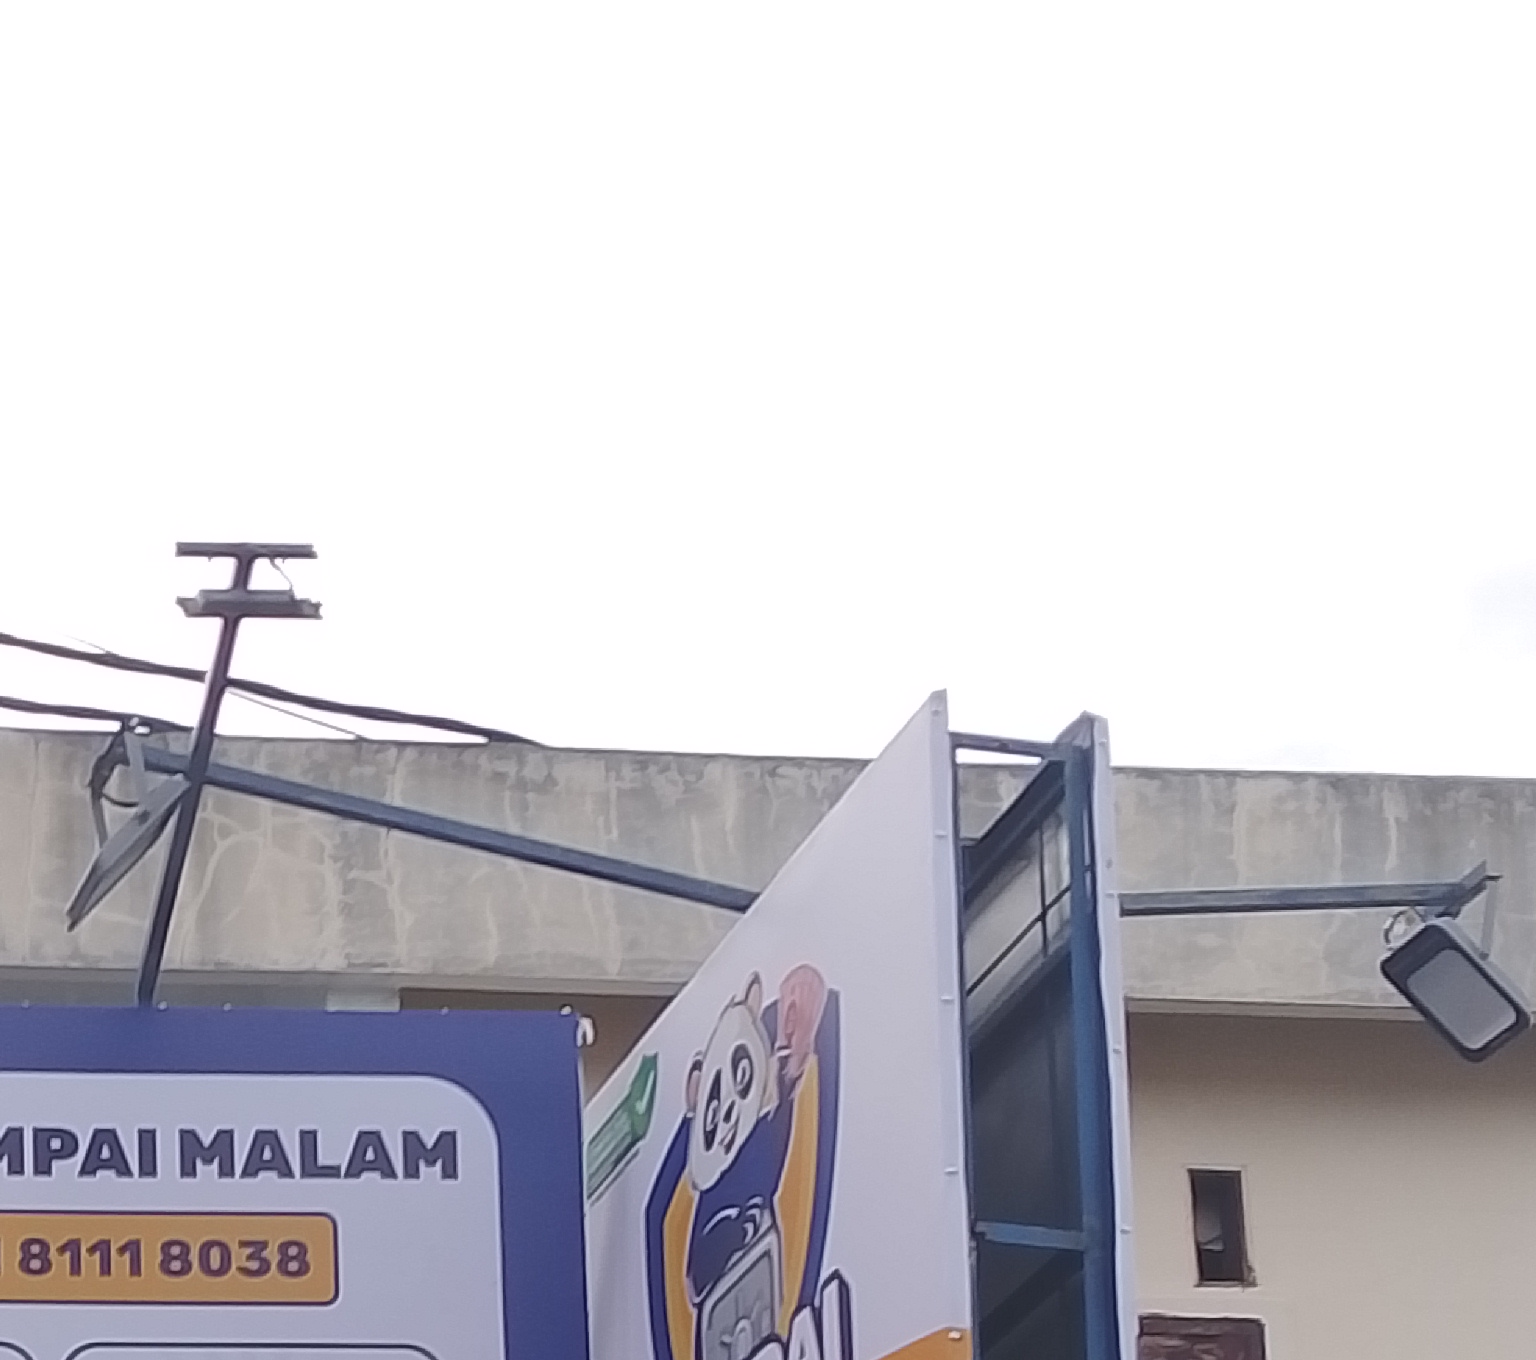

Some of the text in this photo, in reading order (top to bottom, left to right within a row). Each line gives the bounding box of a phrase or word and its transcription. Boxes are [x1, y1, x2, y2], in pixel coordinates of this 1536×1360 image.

[178, 1127, 460, 1181] MALAM
[17, 1237, 143, 1278] 8111
[159, 1238, 312, 1280] 8038
